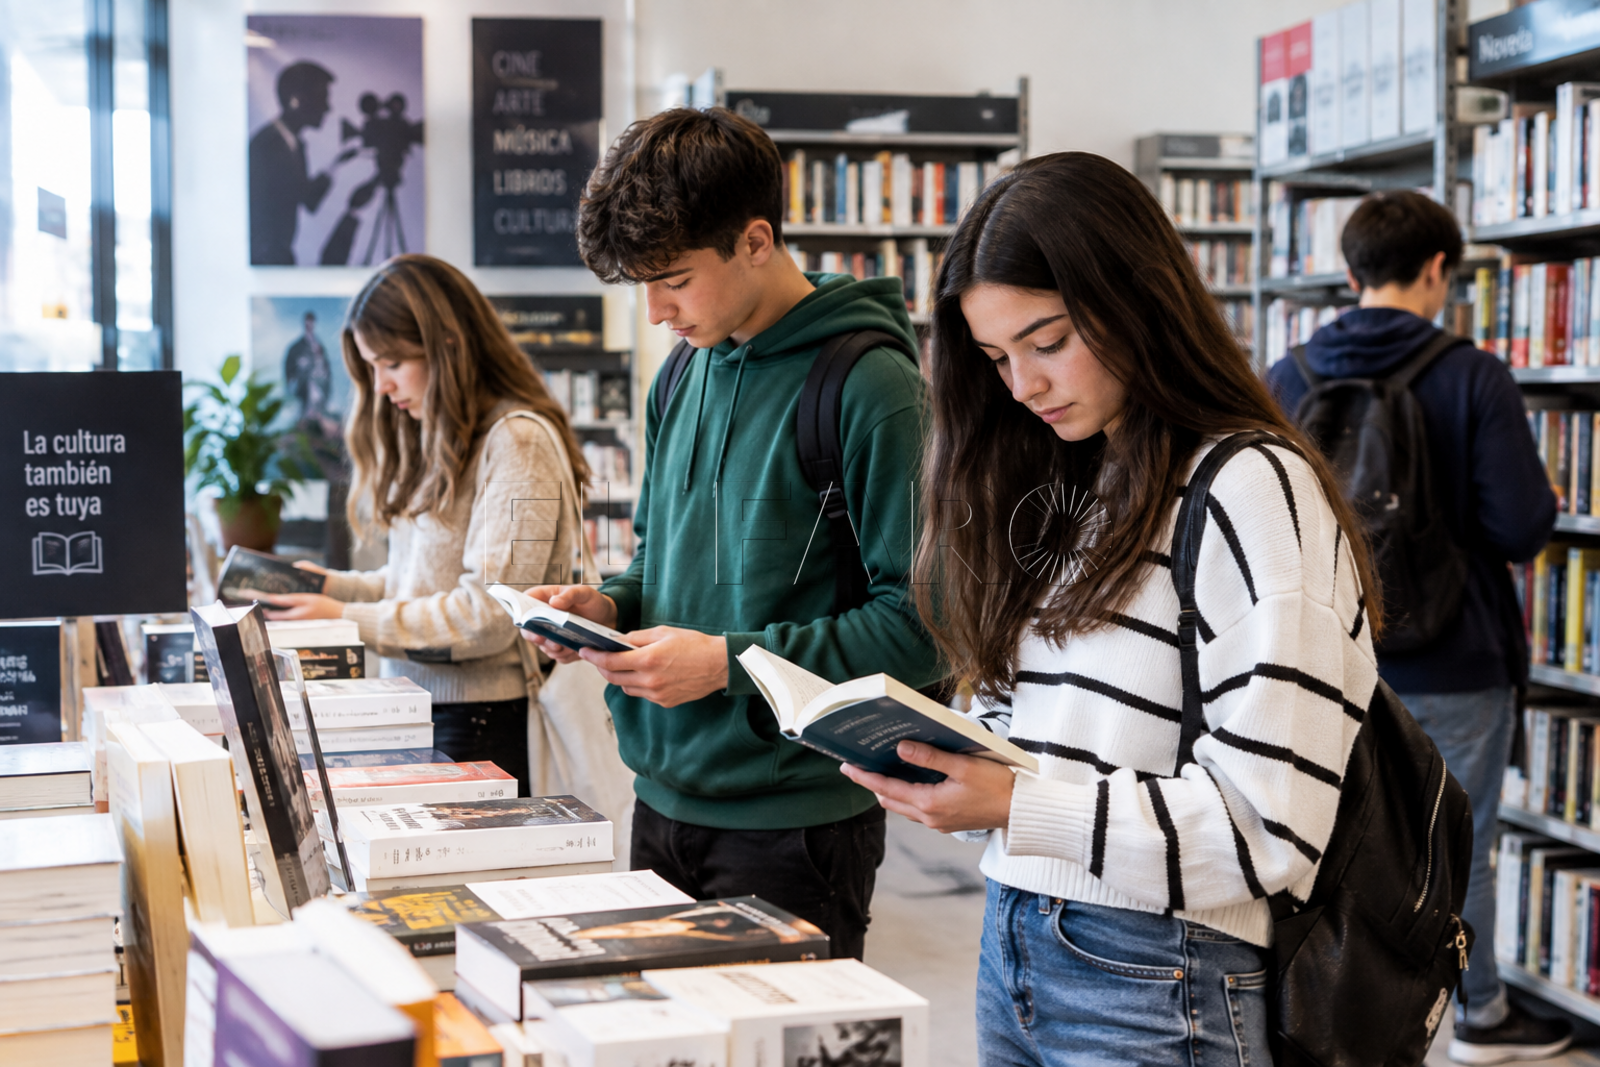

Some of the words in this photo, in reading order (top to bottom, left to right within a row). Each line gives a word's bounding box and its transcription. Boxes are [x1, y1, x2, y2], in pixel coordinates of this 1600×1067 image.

[492, 90, 545, 115] ARTE
[494, 169, 567, 195] LIBROS
[24, 430, 47, 454] La
[53, 429, 126, 454] cultura
[25, 460, 111, 485] también
[26, 497, 50, 517] es
[56, 493, 102, 521] tuya
